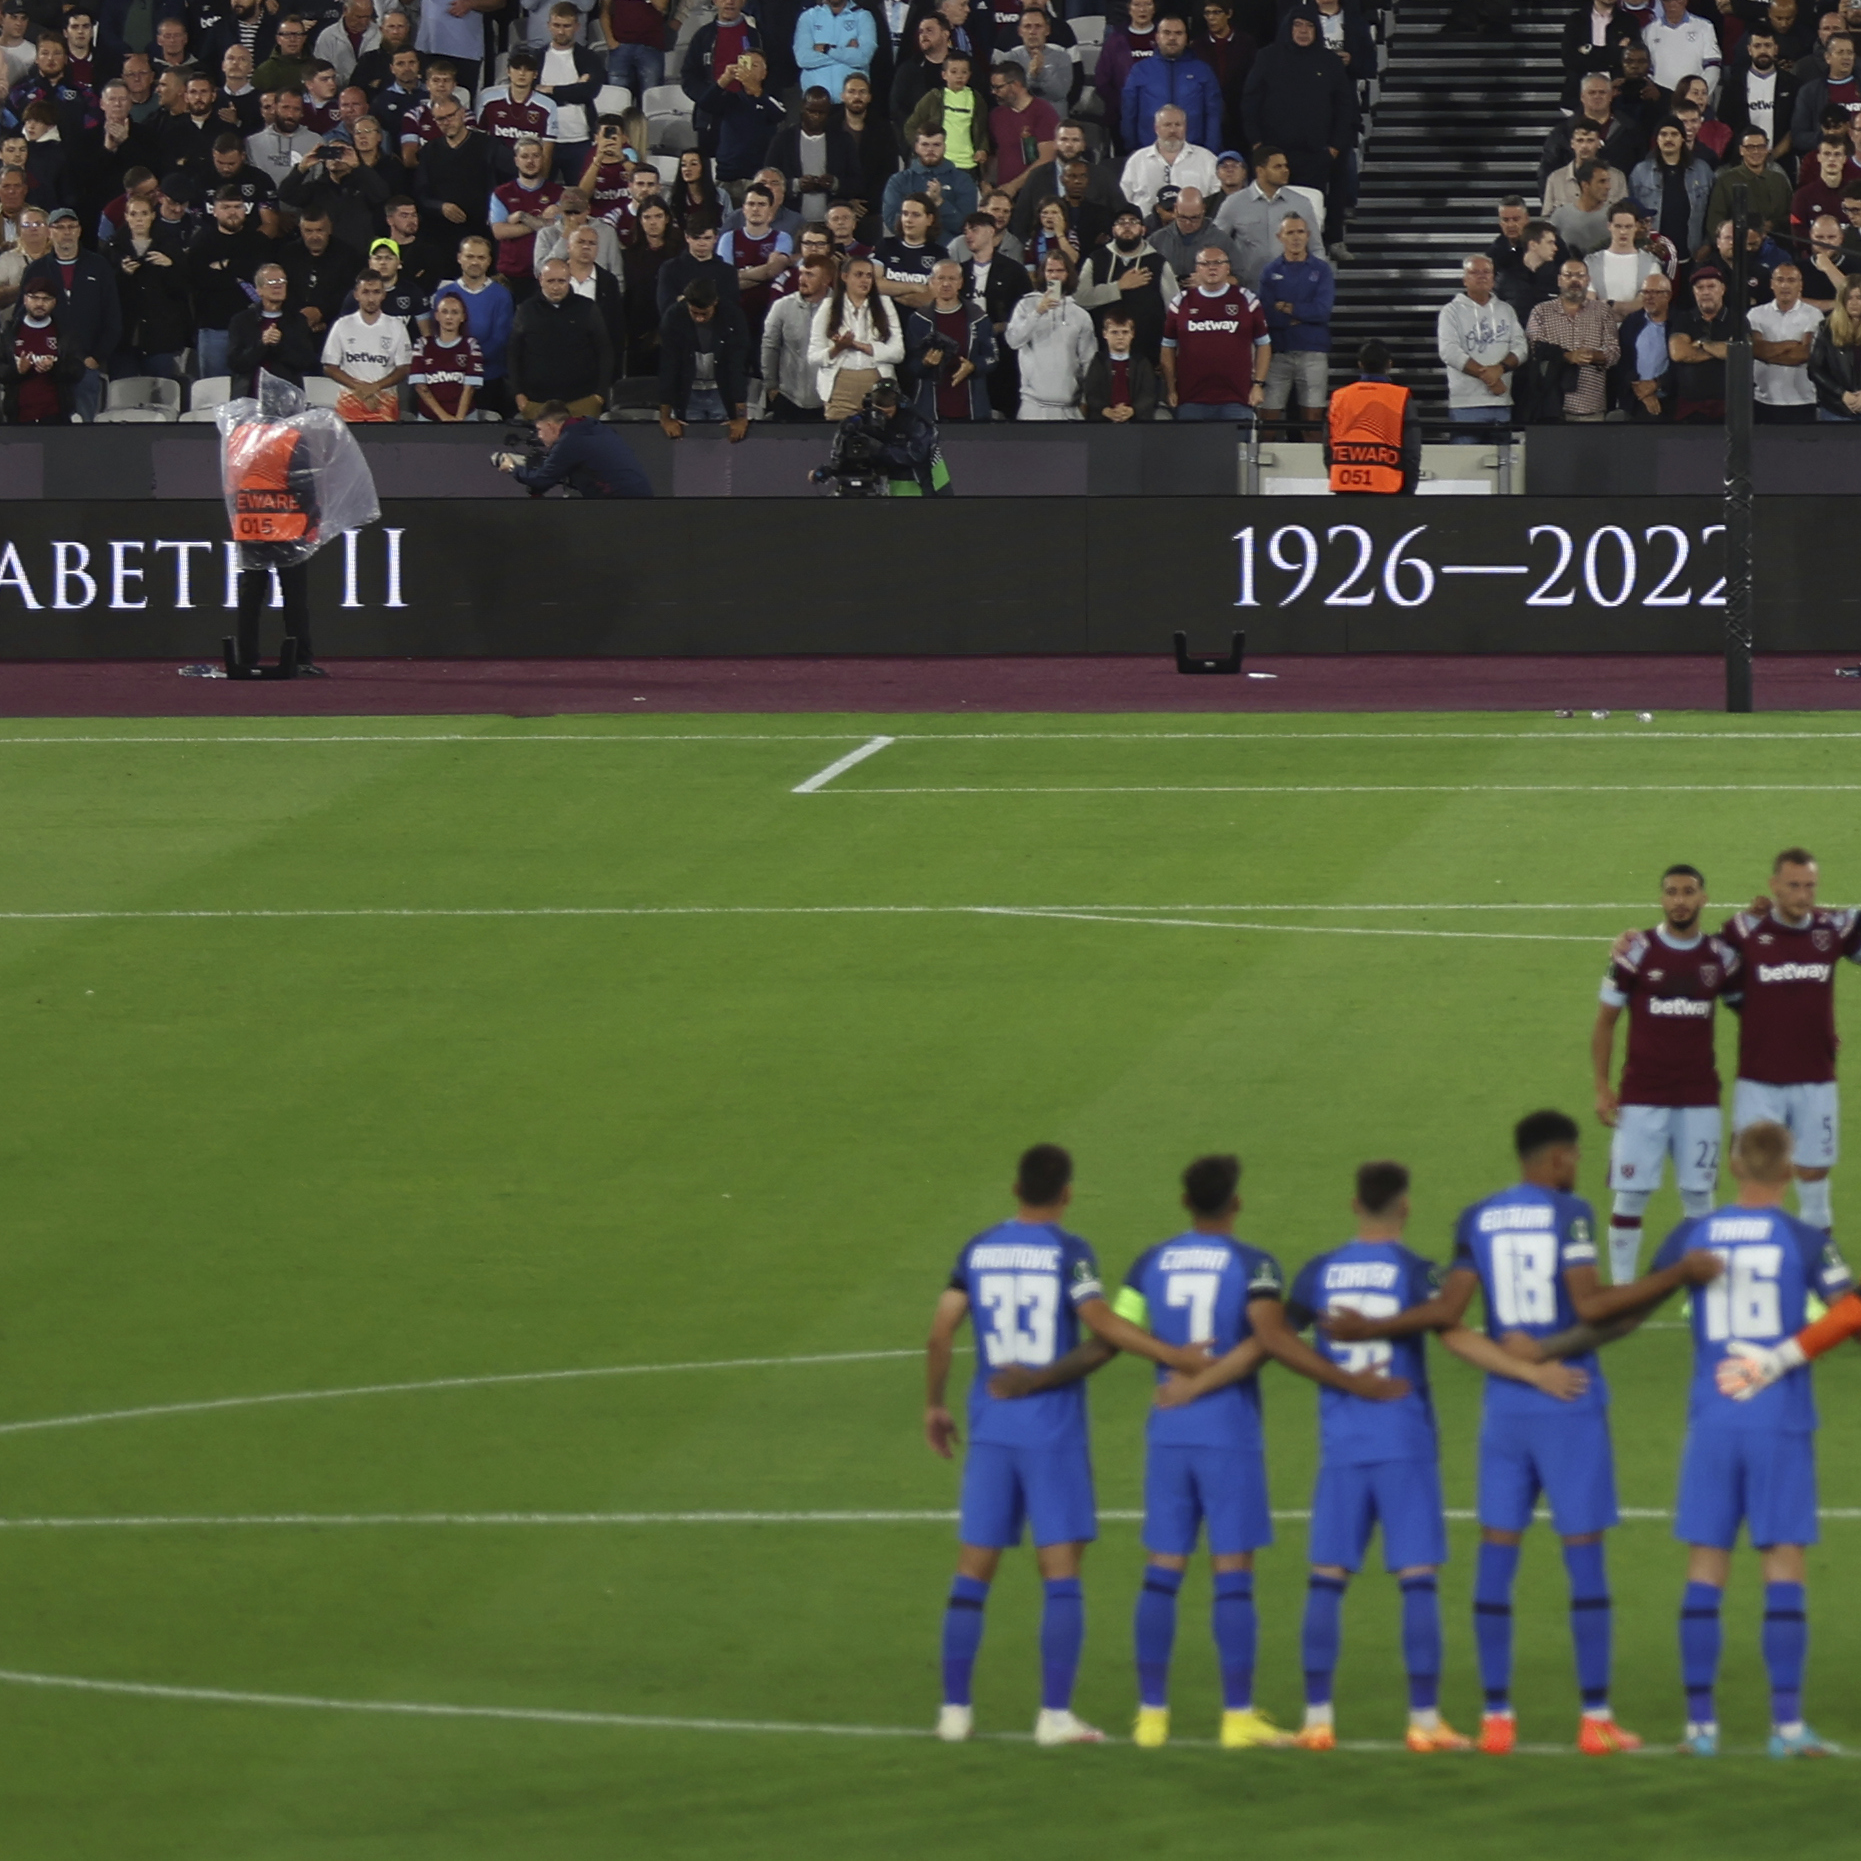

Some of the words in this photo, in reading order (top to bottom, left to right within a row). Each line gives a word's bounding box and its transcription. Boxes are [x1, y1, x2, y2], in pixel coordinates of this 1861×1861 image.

[1187, 319, 1237, 334] betway
[345, 352, 389, 368] betway
[426, 371, 464, 385] betway
[1338, 466, 1374, 487] 051
[342, 528, 408, 607] II
[1758, 961, 1830, 985] betway
[1649, 998, 1711, 1019] betway
[1490, 1234, 1557, 1326] 18
[980, 1274, 1060, 1367] 33
[1167, 1275, 1219, 1354] 7
